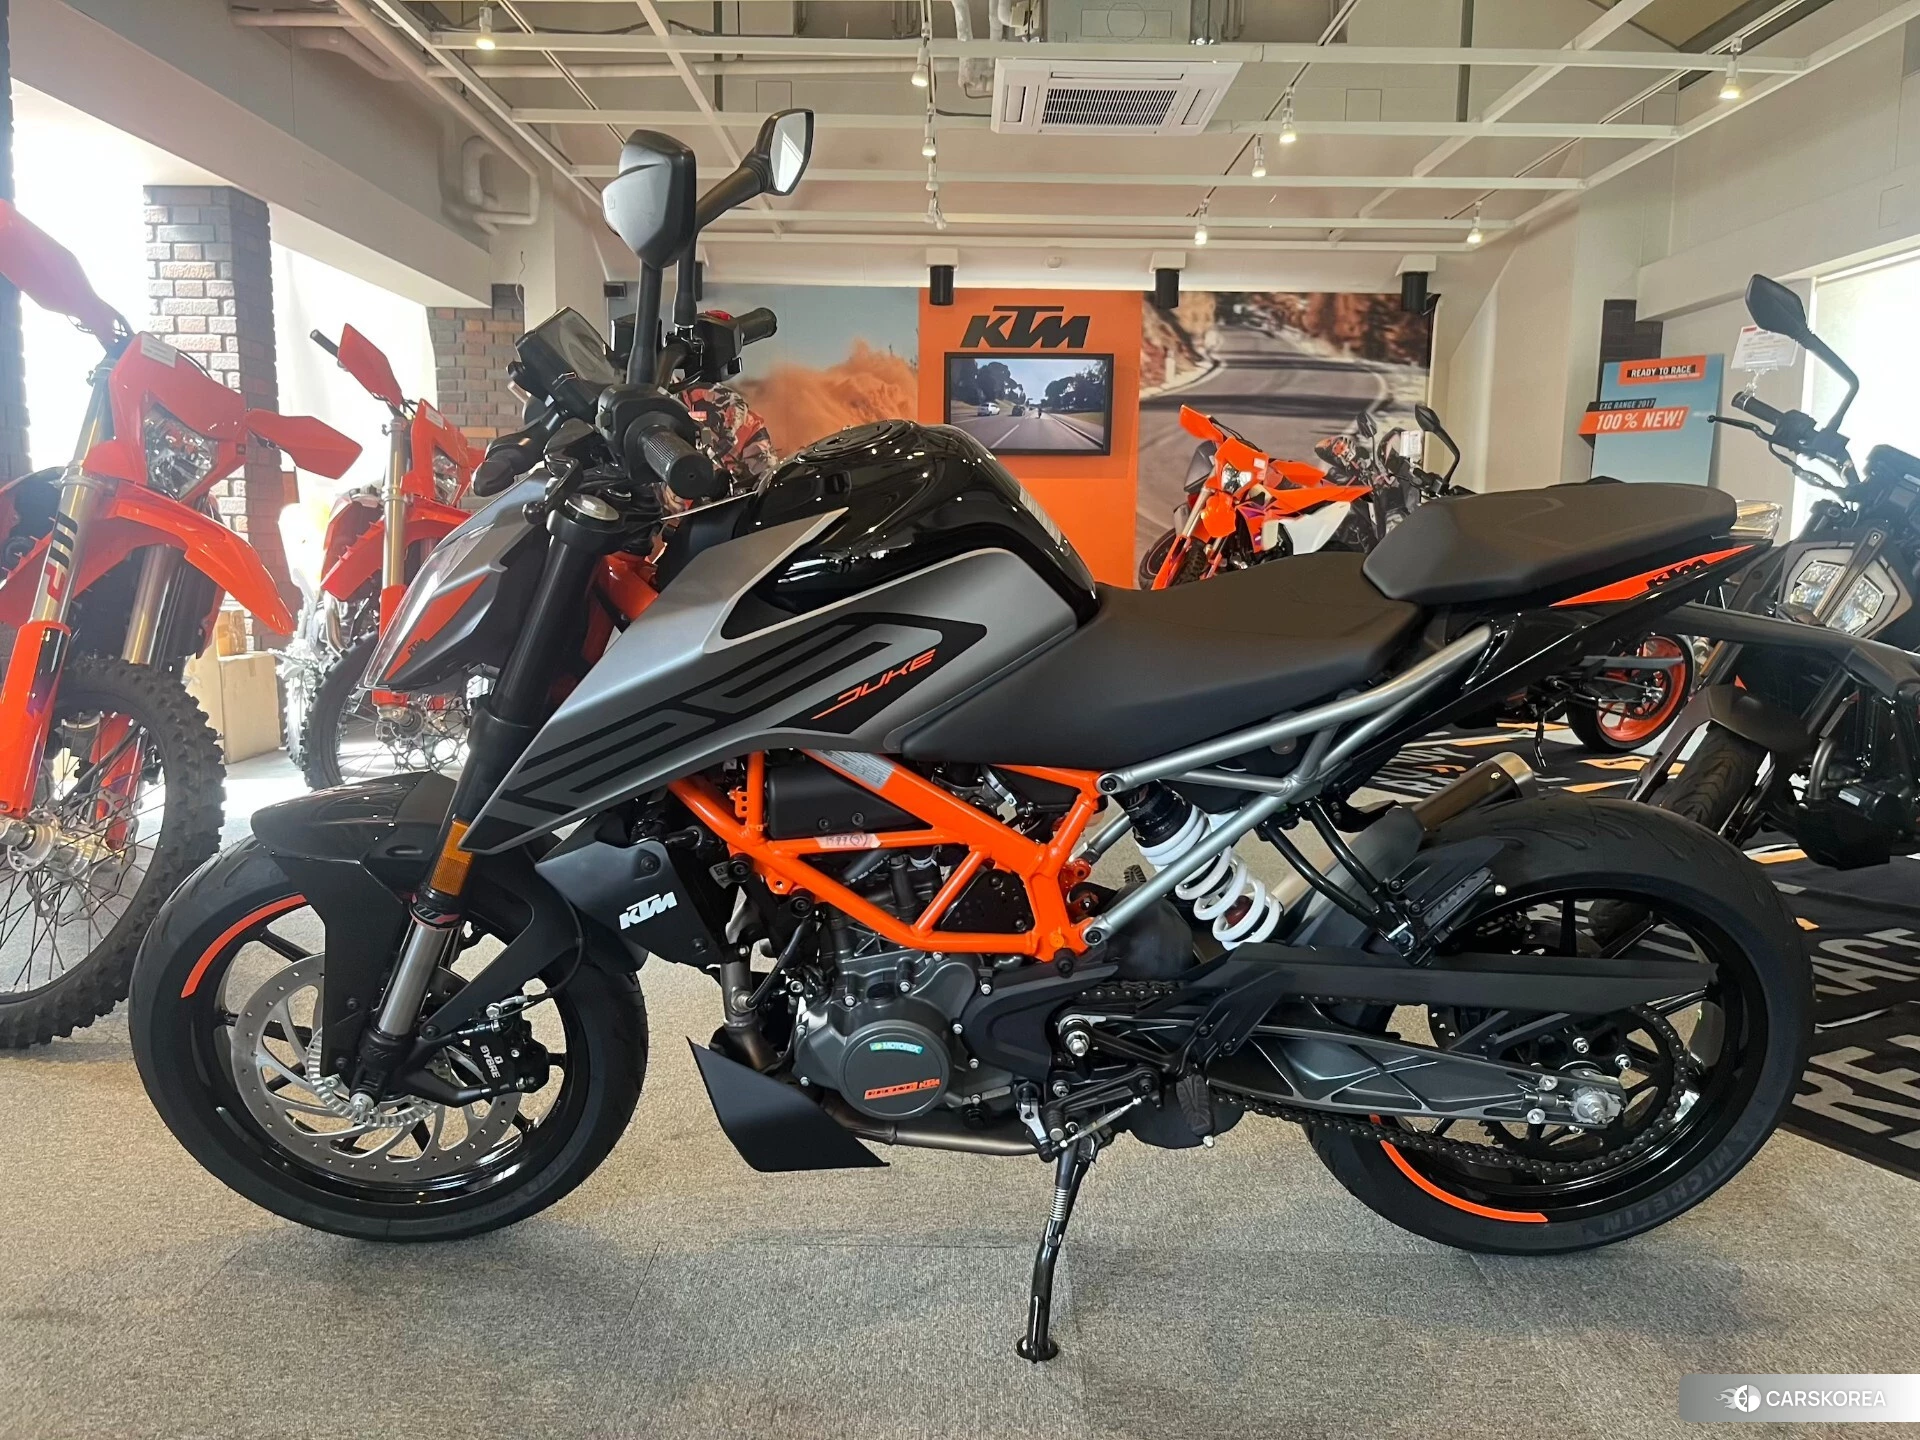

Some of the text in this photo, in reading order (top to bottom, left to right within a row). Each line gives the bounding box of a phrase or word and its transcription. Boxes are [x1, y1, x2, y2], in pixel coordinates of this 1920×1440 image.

[961, 305, 1091, 349] KTM
[1631, 367, 1656, 378] READY
[1659, 366, 1669, 376] TO
[1670, 364, 1691, 375] RACE
[1637, 399, 1655, 409] 2017
[1643, 410, 1685, 428] NEW!
[811, 648, 936, 720] DUKE
[619, 891, 678, 930] KTM
[480, 1045, 500, 1078] BYBRE
[1603, 1144, 1734, 1234] MICHELIN
